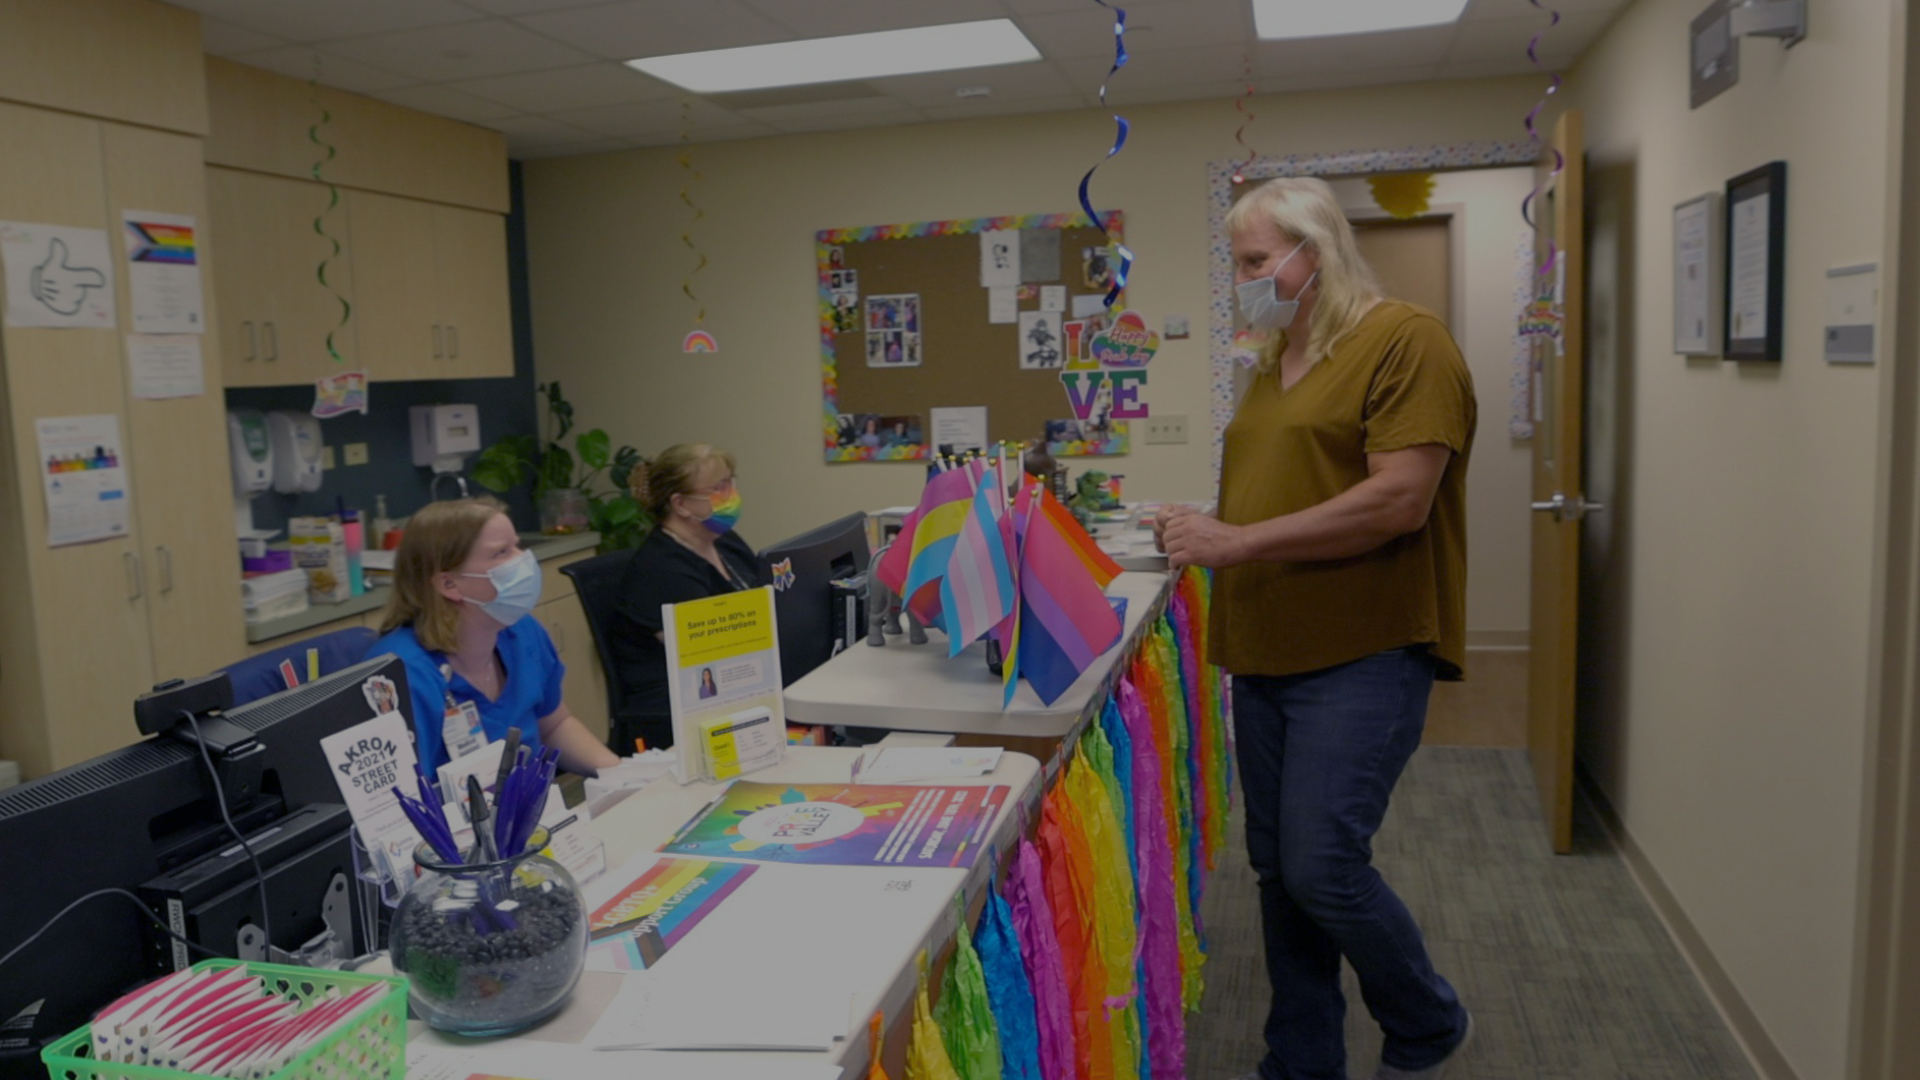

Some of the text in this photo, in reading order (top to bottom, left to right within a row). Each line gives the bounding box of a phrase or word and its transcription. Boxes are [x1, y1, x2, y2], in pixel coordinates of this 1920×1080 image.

[1109, 327, 1150, 347] Happy
[687, 620, 705, 630] Save
[707, 618, 717, 626] up
[688, 620, 757, 640] your prescriptions
[338, 737, 397, 776] AKRON
[355, 750, 386, 771] 2021
[352, 759, 398, 787] STREET
[363, 773, 396, 794] CARD
[668, 876, 709, 905] Group
[593, 884, 658, 928] LGBTQ+
